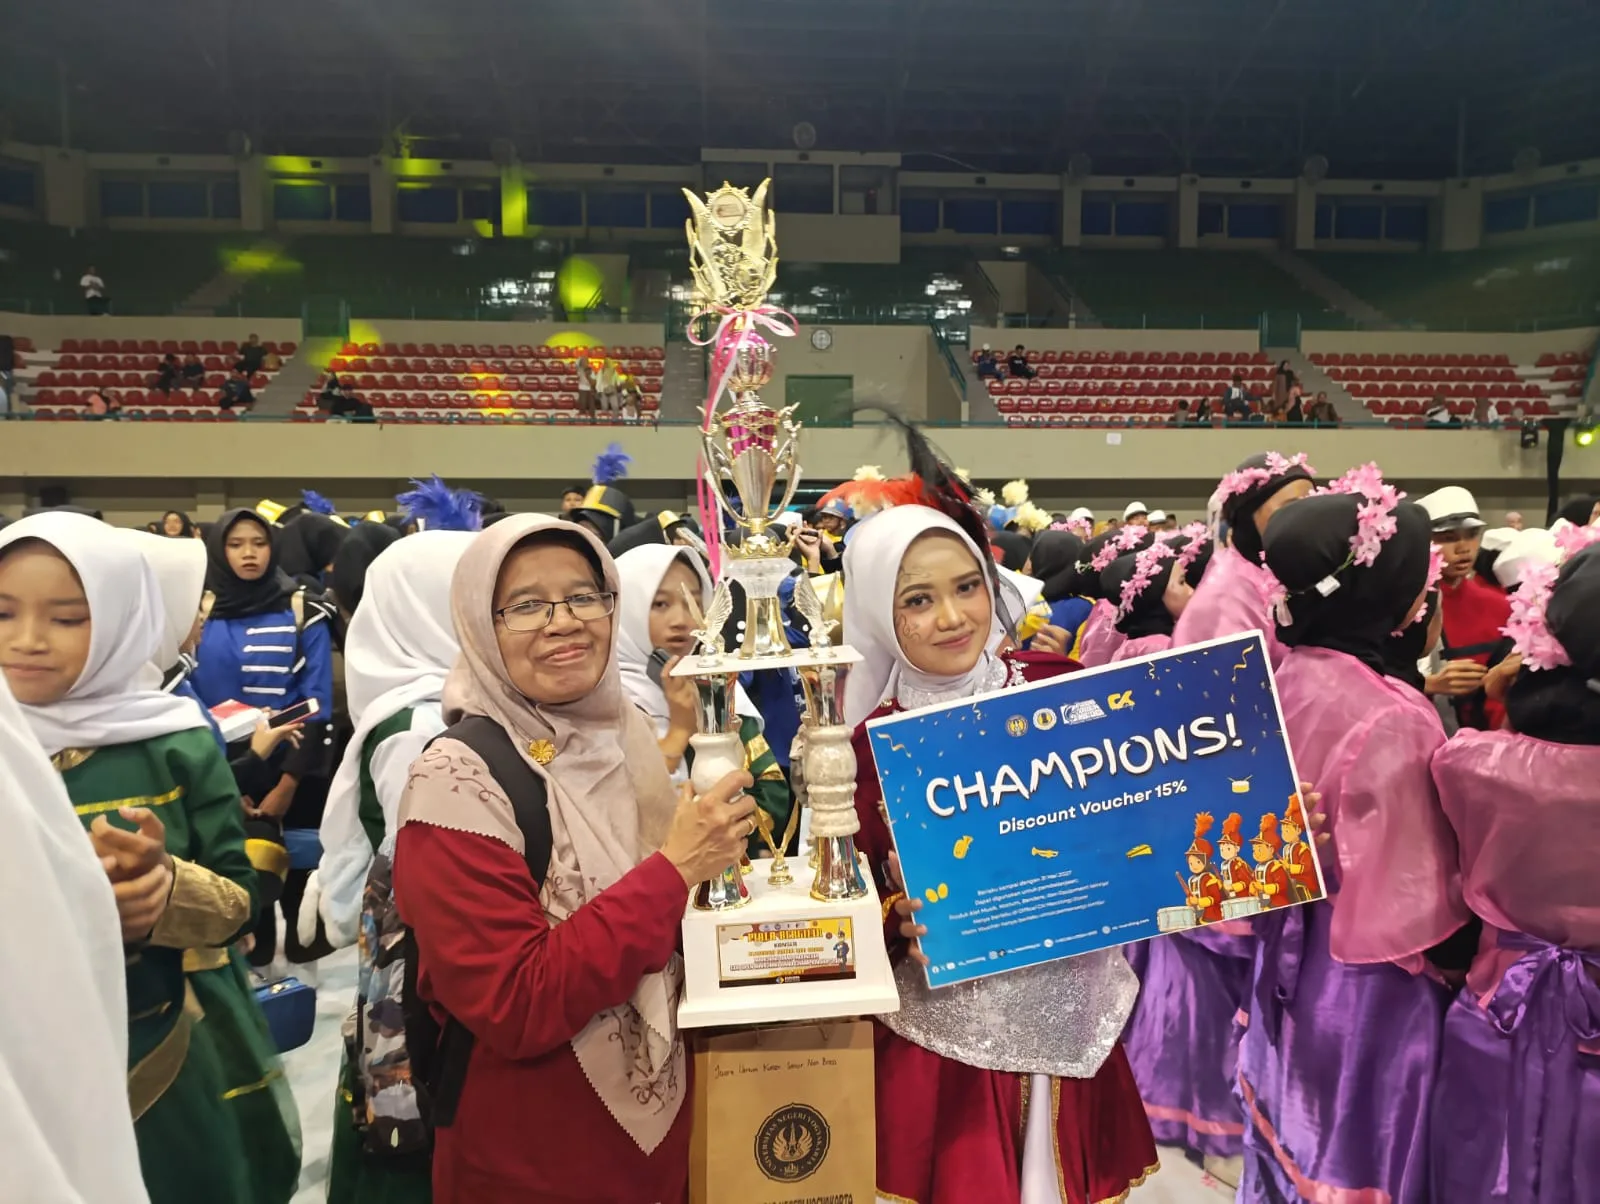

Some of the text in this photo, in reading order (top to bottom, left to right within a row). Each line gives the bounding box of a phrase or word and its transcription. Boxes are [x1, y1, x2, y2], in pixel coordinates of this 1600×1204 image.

[926, 713, 1243, 817] CHAMPIONS!
[999, 779, 1187, 834] Discount Voucher 15%
